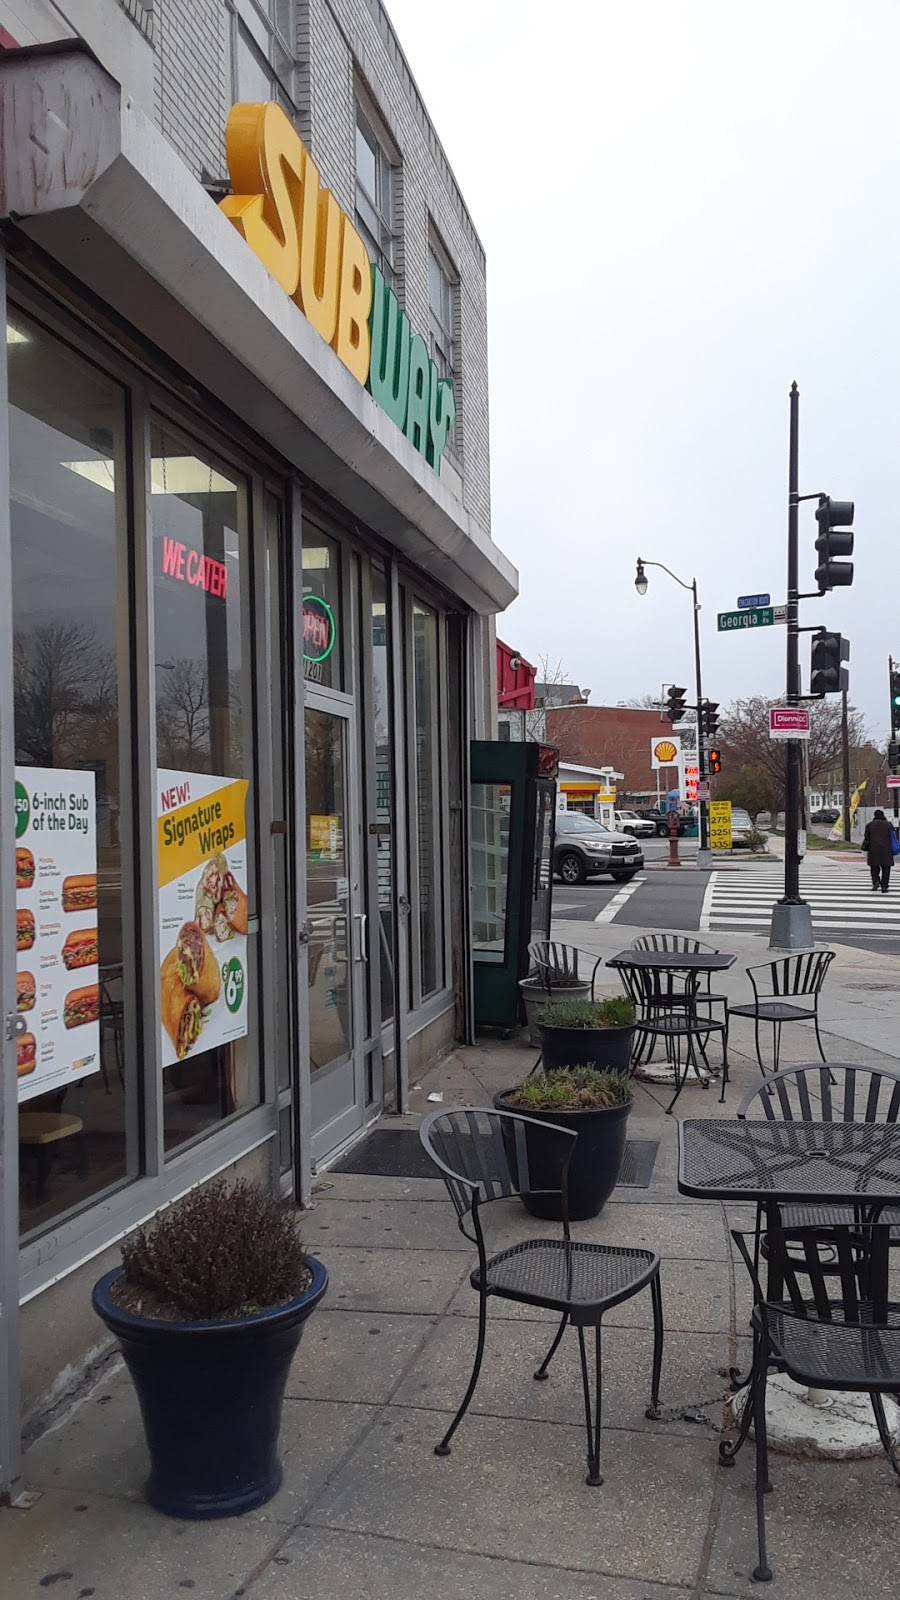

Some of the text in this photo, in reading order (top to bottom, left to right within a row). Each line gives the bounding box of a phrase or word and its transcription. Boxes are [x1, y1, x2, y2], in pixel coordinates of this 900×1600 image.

[216, 100, 457, 477] SUBWAY
[162, 536, 228, 600] WE CATER
[720, 611, 758, 628] Georgia
[32, 792, 89, 811] 6-inch Sub
[161, 781, 191, 812] NEW!
[32, 812, 89, 835] of the Day
[163, 801, 222, 847] Signature
[198, 821, 235, 855] Wraps
